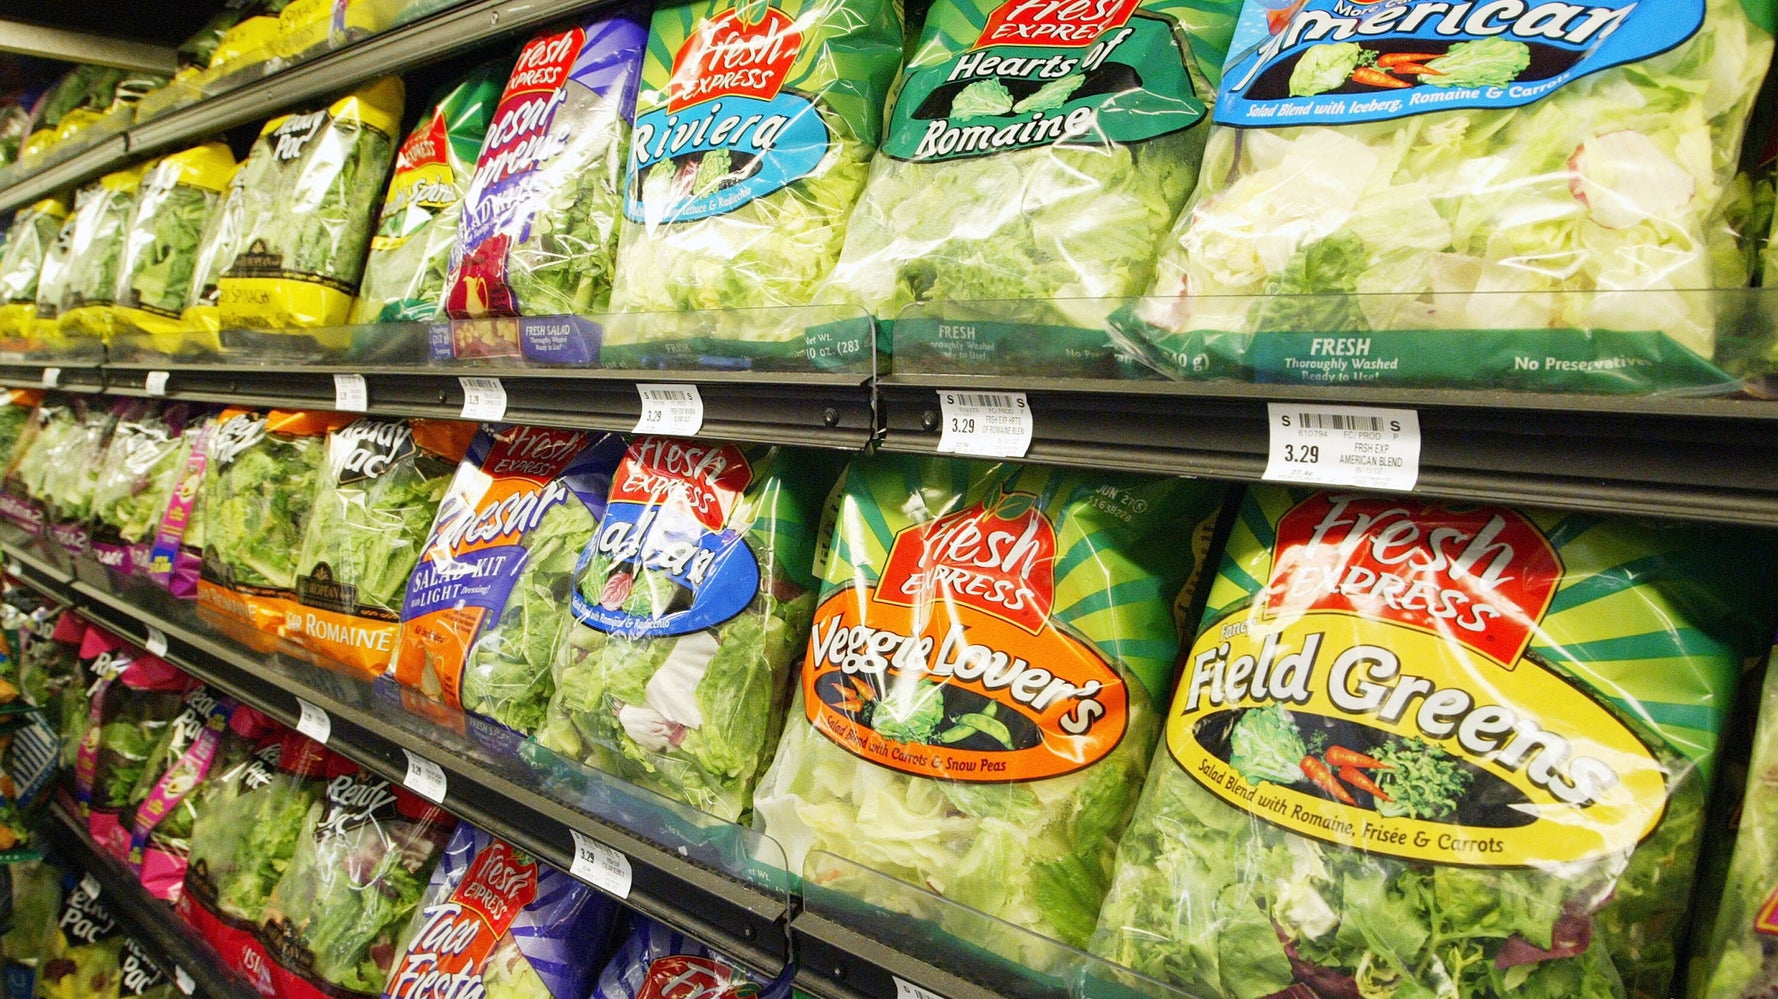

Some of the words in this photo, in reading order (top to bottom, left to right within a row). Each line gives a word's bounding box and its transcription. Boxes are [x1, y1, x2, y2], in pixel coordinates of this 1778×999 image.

[690, 17, 784, 72] Fresh
[991, 16, 1114, 40] EXPRES
[518, 30, 574, 71] resh
[947, 52, 1079, 81] Hearts
[1081, 28, 1137, 72] of
[511, 67, 562, 89] XPRESS
[682, 69, 774, 98] EXPRESS
[1246, 101, 1275, 117] Salad
[1277, 100, 1312, 116] Blend
[1314, 99, 1346, 114] with
[1349, 98, 1403, 113] Iceberg,
[1409, 86, 1480, 105] Romaine
[1486, 87, 1504, 98] &
[1509, 73, 1570, 97] Carrots
[634, 103, 790, 164] Riviera
[915, 106, 1097, 157] Romaine
[817, 334, 833, 343] Wt.
[837, 340, 860, 356] (283
[939, 325, 976, 339] FRESH
[1310, 338, 1372, 356] FRESH
[1192, 353, 1210, 371] g)
[1285, 357, 1349, 371] Thoroughly
[1352, 358, 1398, 370] Washed
[1302, 370, 1335, 383] Ready
[1514, 356, 1540, 371] No
[946, 394, 955, 404] S
[1016, 398, 1026, 408] S
[952, 418, 975, 434] 3.29
[1281, 415, 1291, 427] S
[1390, 420, 1401, 432] S
[506, 426, 586, 462] Fresh
[633, 436, 728, 484] Fresh
[1284, 444, 1319, 464] 3.29
[1339, 454, 1378, 466] AMERICAN
[1380, 456, 1403, 468] BLEND
[1354, 443, 1373, 453] FRSH
[1375, 444, 1390, 454] EXP
[336, 448, 386, 478] ac
[493, 459, 557, 476] EXPRESS
[621, 474, 716, 514] EXPRESS
[1096, 484, 1120, 500] JUN
[432, 481, 567, 550] aesar
[917, 511, 1044, 579] Fresh
[1303, 497, 1516, 592] Fresh
[471, 556, 507, 578] KIT
[420, 584, 462, 607] LIGHT
[901, 564, 1036, 611] EXPRESS
[1291, 565, 1501, 632] EXPRESS
[306, 612, 392, 652] ROMAINE
[810, 612, 934, 676] Veggie
[934, 622, 1106, 735] Lover's
[1183, 631, 1323, 715] Field
[1326, 644, 1620, 810] Greens
[827, 715, 846, 736] Salad
[869, 743, 889, 757] with
[891, 747, 928, 766] Carrots
[931, 755, 942, 768] &
[945, 757, 977, 771] Snow
[981, 758, 1007, 772] Peas
[1198, 758, 1226, 784] Salad
[1225, 776, 1258, 802] Blend
[1259, 796, 1287, 815] with
[1290, 804, 1356, 837] Romaine,
[1364, 821, 1407, 845] Frisée
[1413, 831, 1430, 848] &
[1438, 833, 1504, 853] Carrots
[478, 843, 532, 899] Fresh
[60, 908, 101, 943] Pac
[407, 903, 481, 954] Taco
[123, 955, 152, 996] Pac
[390, 953, 485, 999] Fiesta
